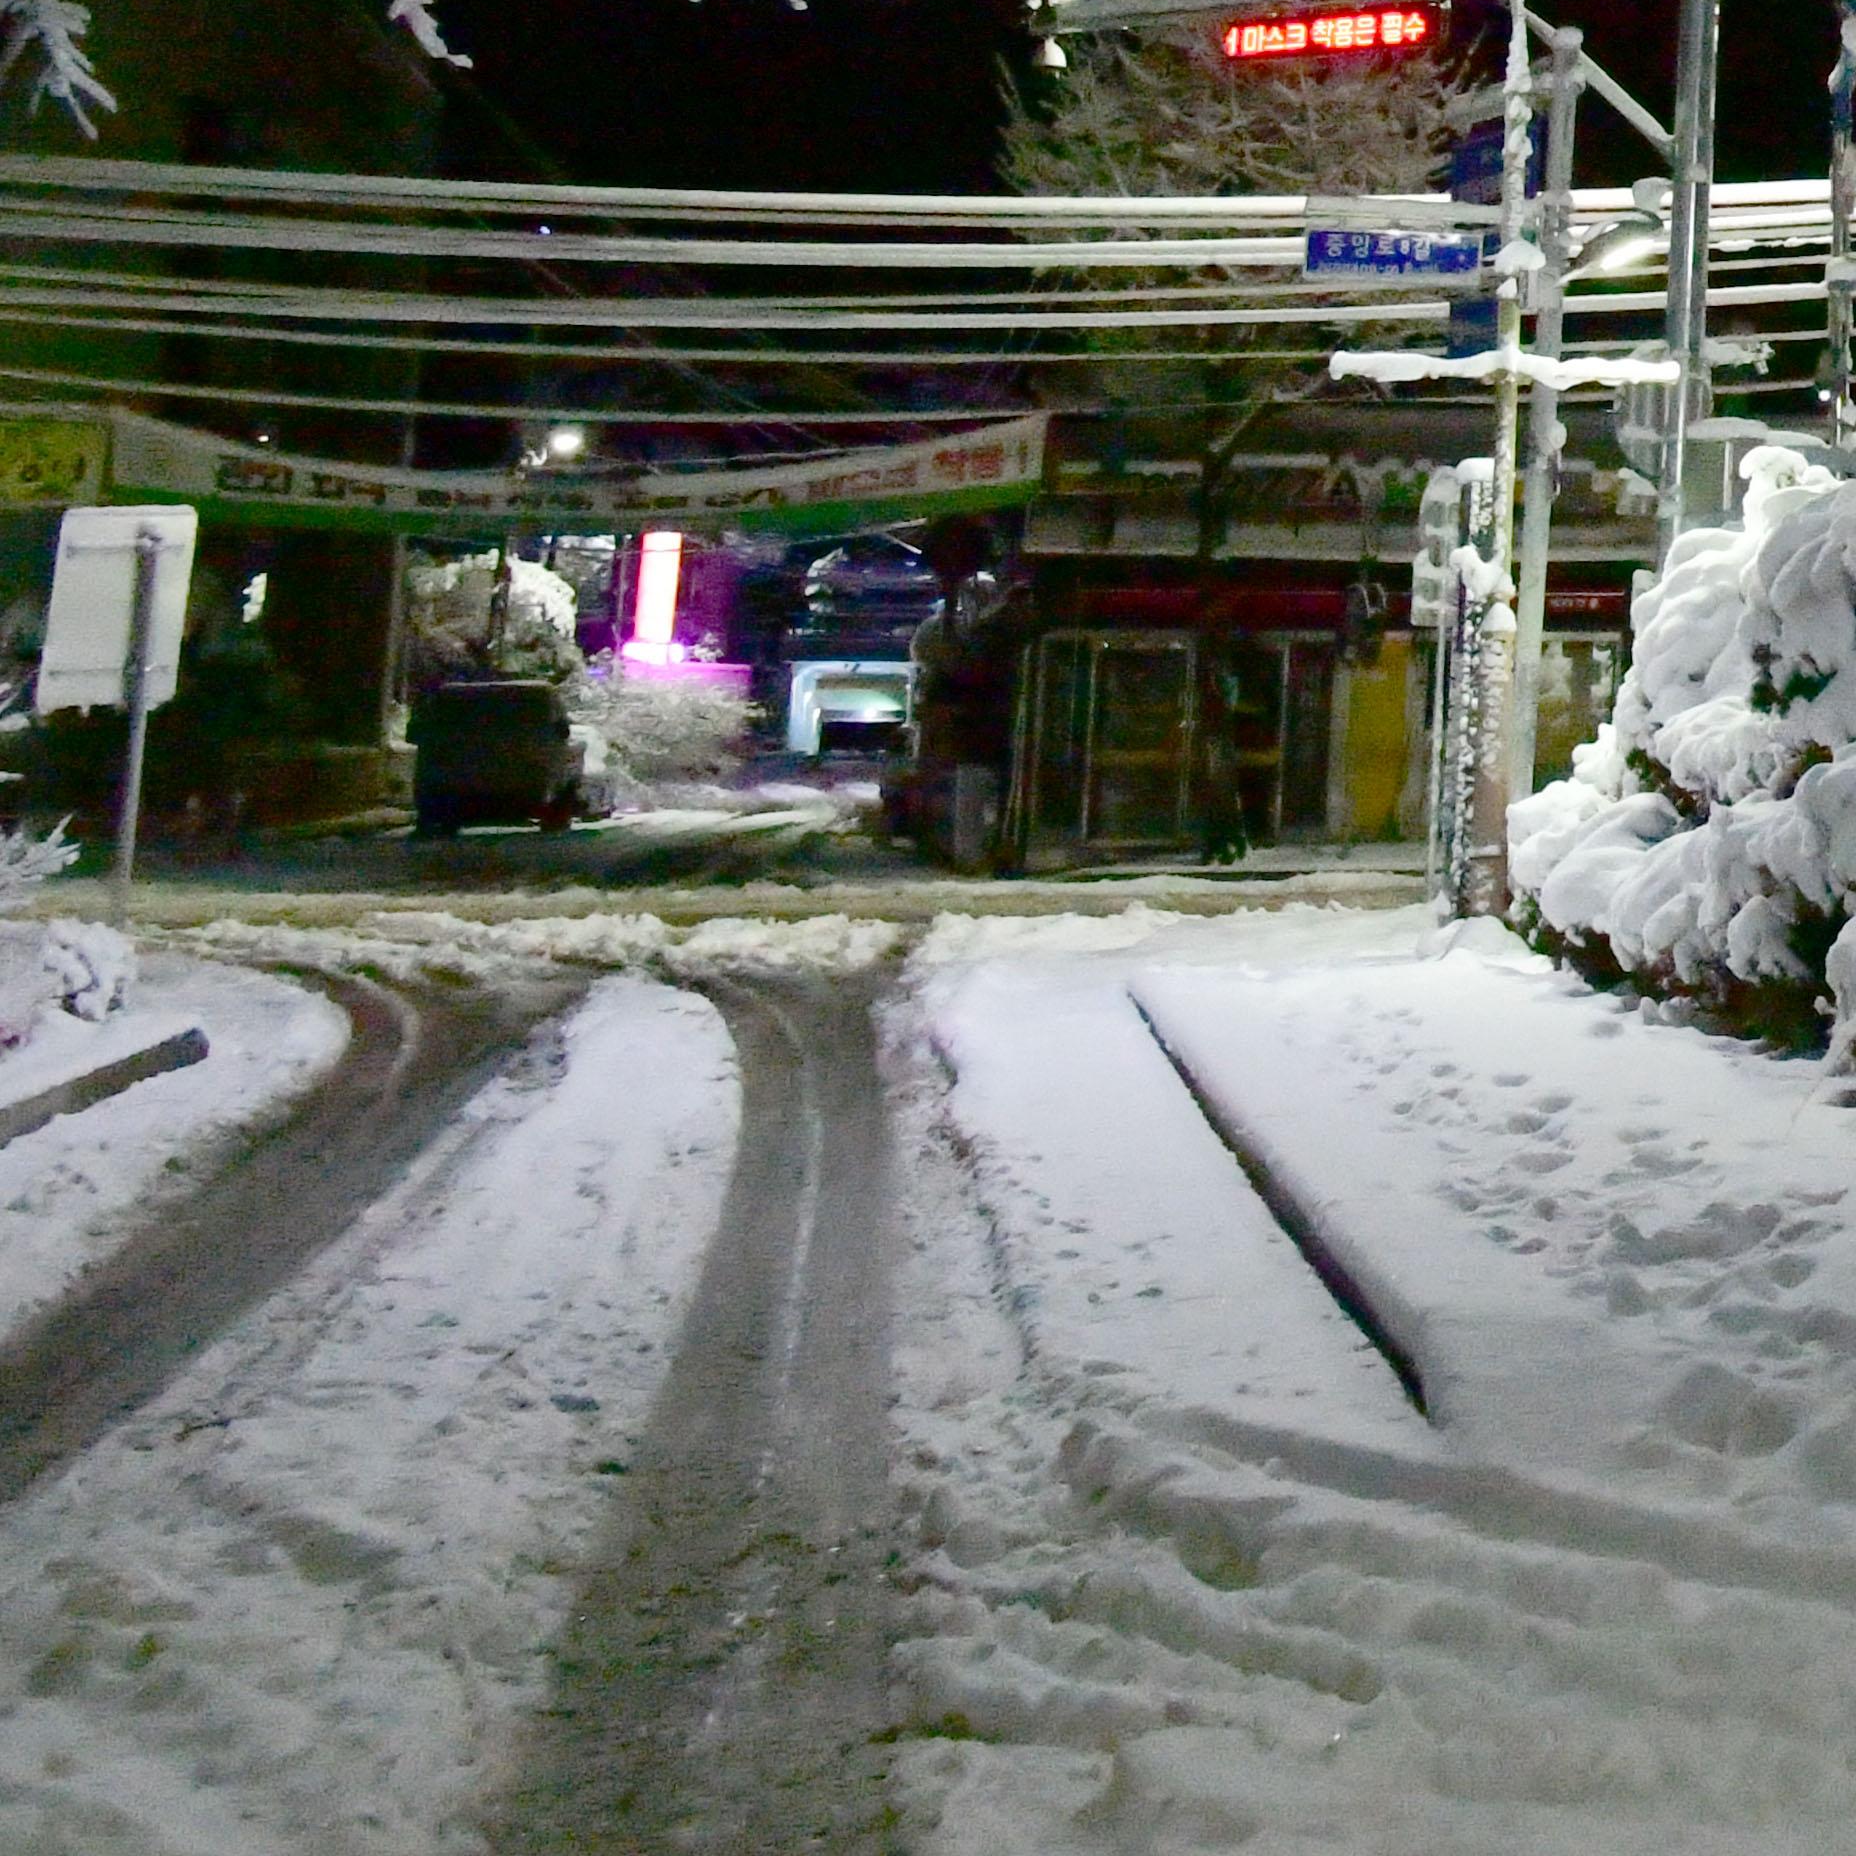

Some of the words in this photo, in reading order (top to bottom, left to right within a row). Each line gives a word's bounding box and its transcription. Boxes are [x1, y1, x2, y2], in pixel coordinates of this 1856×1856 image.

[1243, 23, 1306, 53] 마스크
[1311, 14, 1376, 48] 착용은
[1381, 11, 1426, 44] 필수
